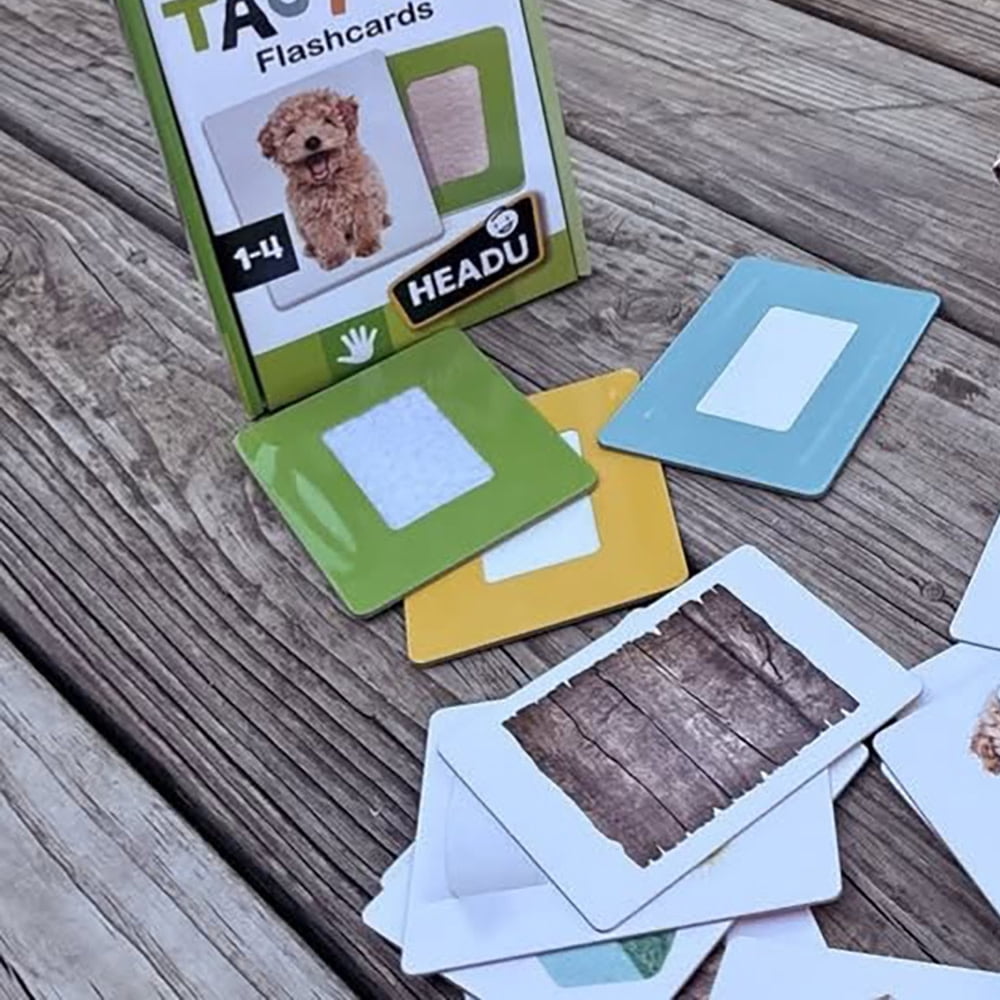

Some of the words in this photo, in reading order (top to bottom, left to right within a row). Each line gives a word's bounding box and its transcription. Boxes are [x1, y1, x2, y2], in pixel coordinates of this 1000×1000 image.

[255, 1, 435, 74] Flashcards
[233, 235, 283, 270] 1-4
[407, 233, 530, 307] HEADU
